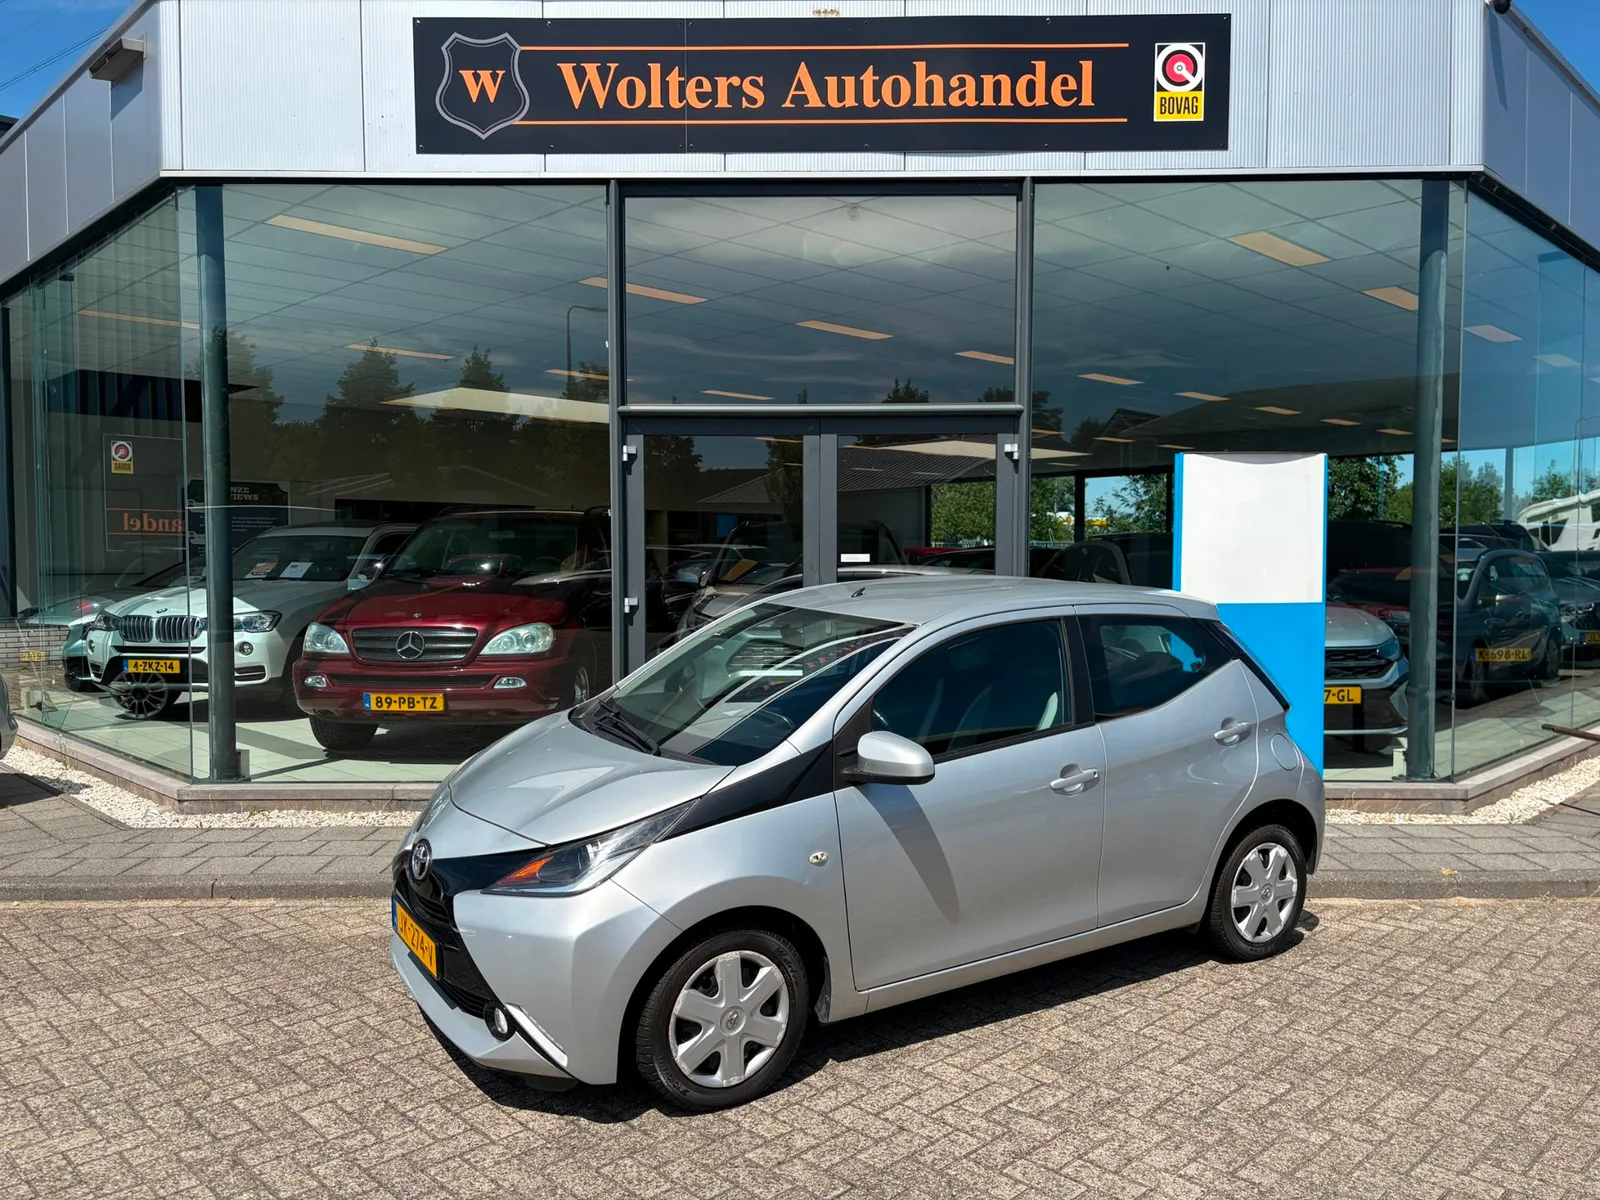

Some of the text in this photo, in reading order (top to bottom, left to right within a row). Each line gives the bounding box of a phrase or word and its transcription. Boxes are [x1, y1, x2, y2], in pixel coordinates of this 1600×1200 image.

[459, 69, 505, 104] W
[558, 60, 1095, 110] Wolters Autohandel
[1159, 96, 1200, 116] BOVAG
[133, 661, 174, 672] 4-ZKZ-14
[375, 696, 438, 709] 89-PB-TZ
